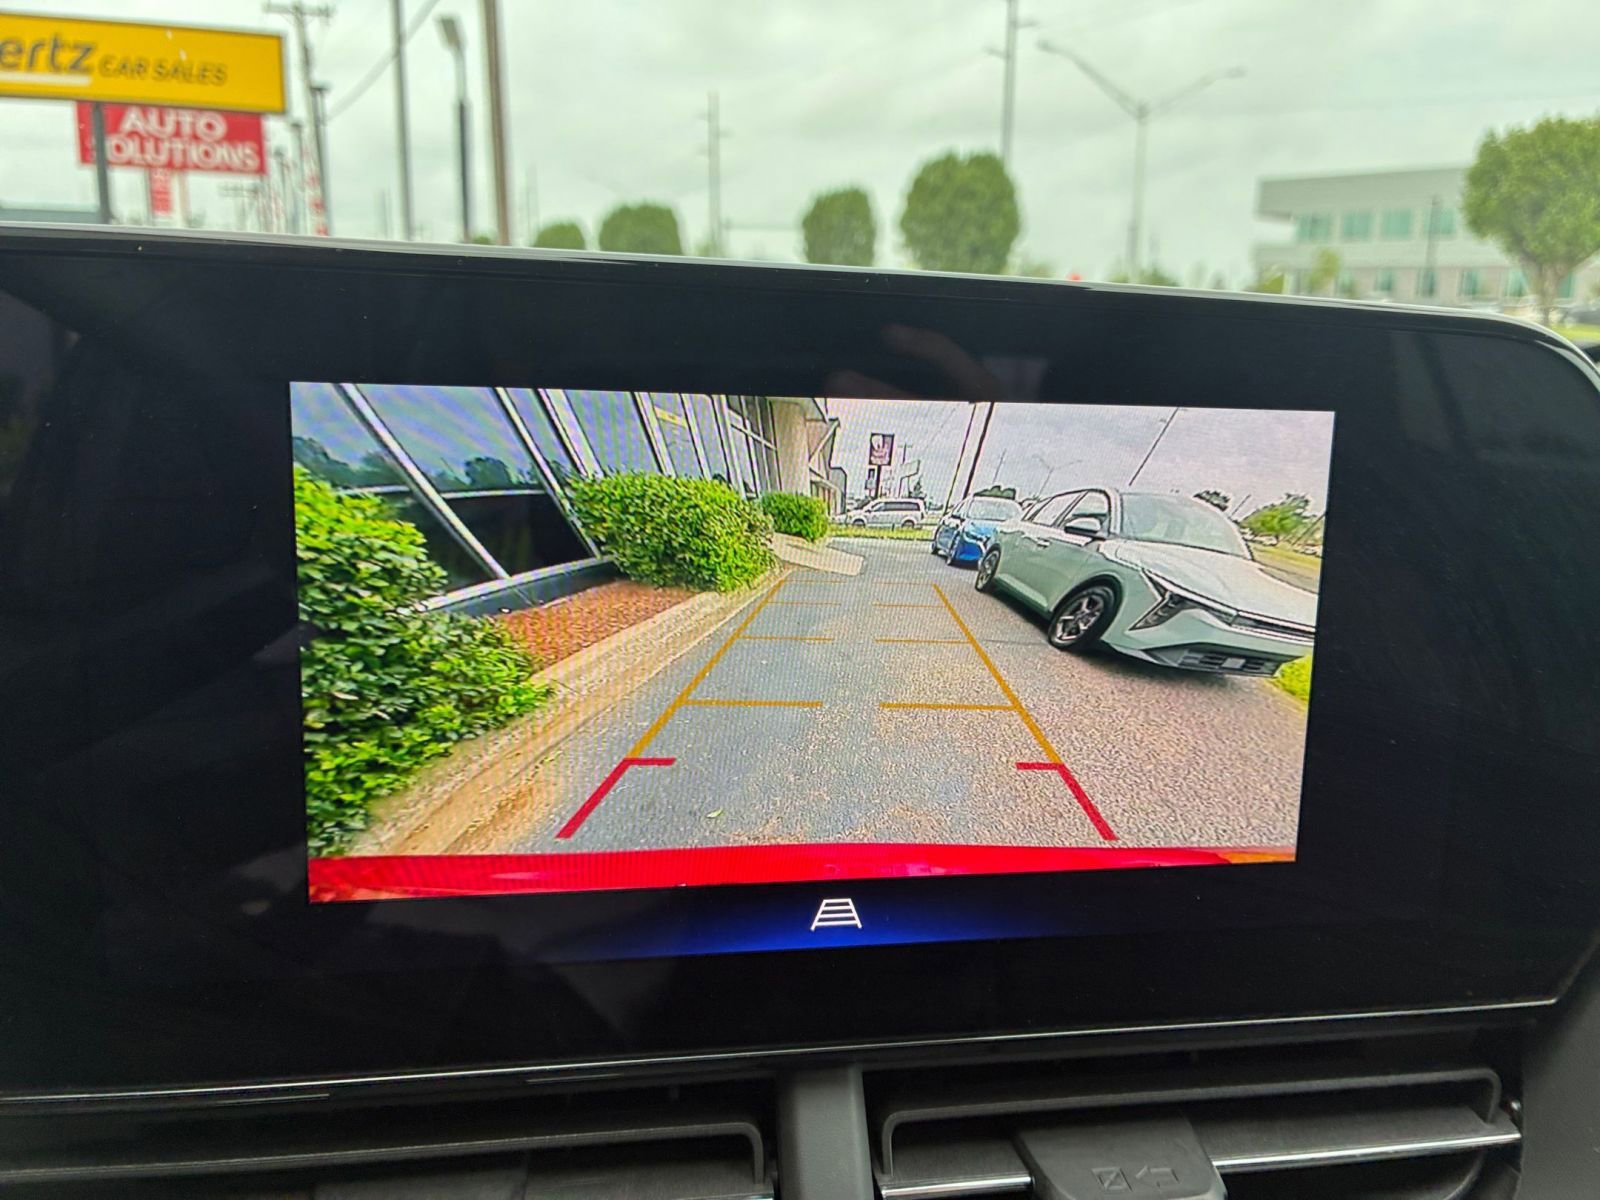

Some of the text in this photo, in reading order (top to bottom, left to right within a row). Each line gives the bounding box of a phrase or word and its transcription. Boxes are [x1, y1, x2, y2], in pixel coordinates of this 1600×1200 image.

[0, 33, 227, 86] ertz CAR SALES
[120, 104, 227, 141] AUTO
[93, 134, 260, 172] OLUTIONS
